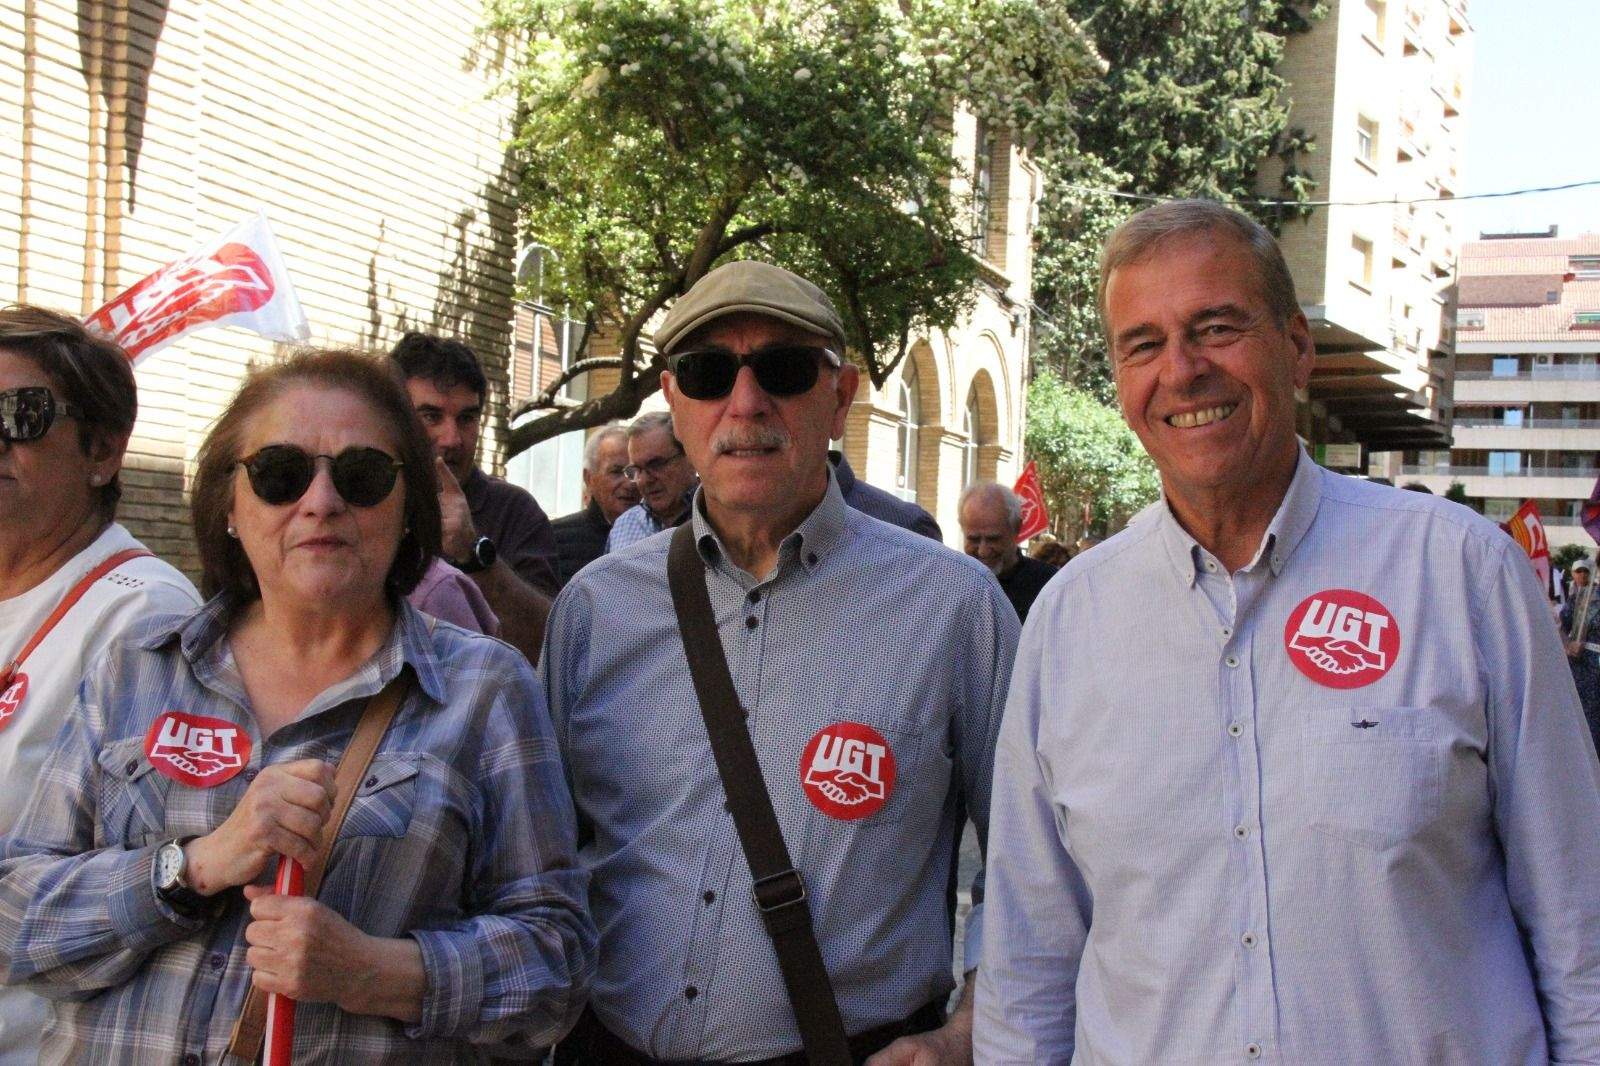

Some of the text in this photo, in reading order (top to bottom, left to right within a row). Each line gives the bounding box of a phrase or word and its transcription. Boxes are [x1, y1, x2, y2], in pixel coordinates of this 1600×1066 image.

[1299, 599, 1389, 653] UGT
[157, 717, 238, 757] UGT
[811, 734, 886, 783] UGT
